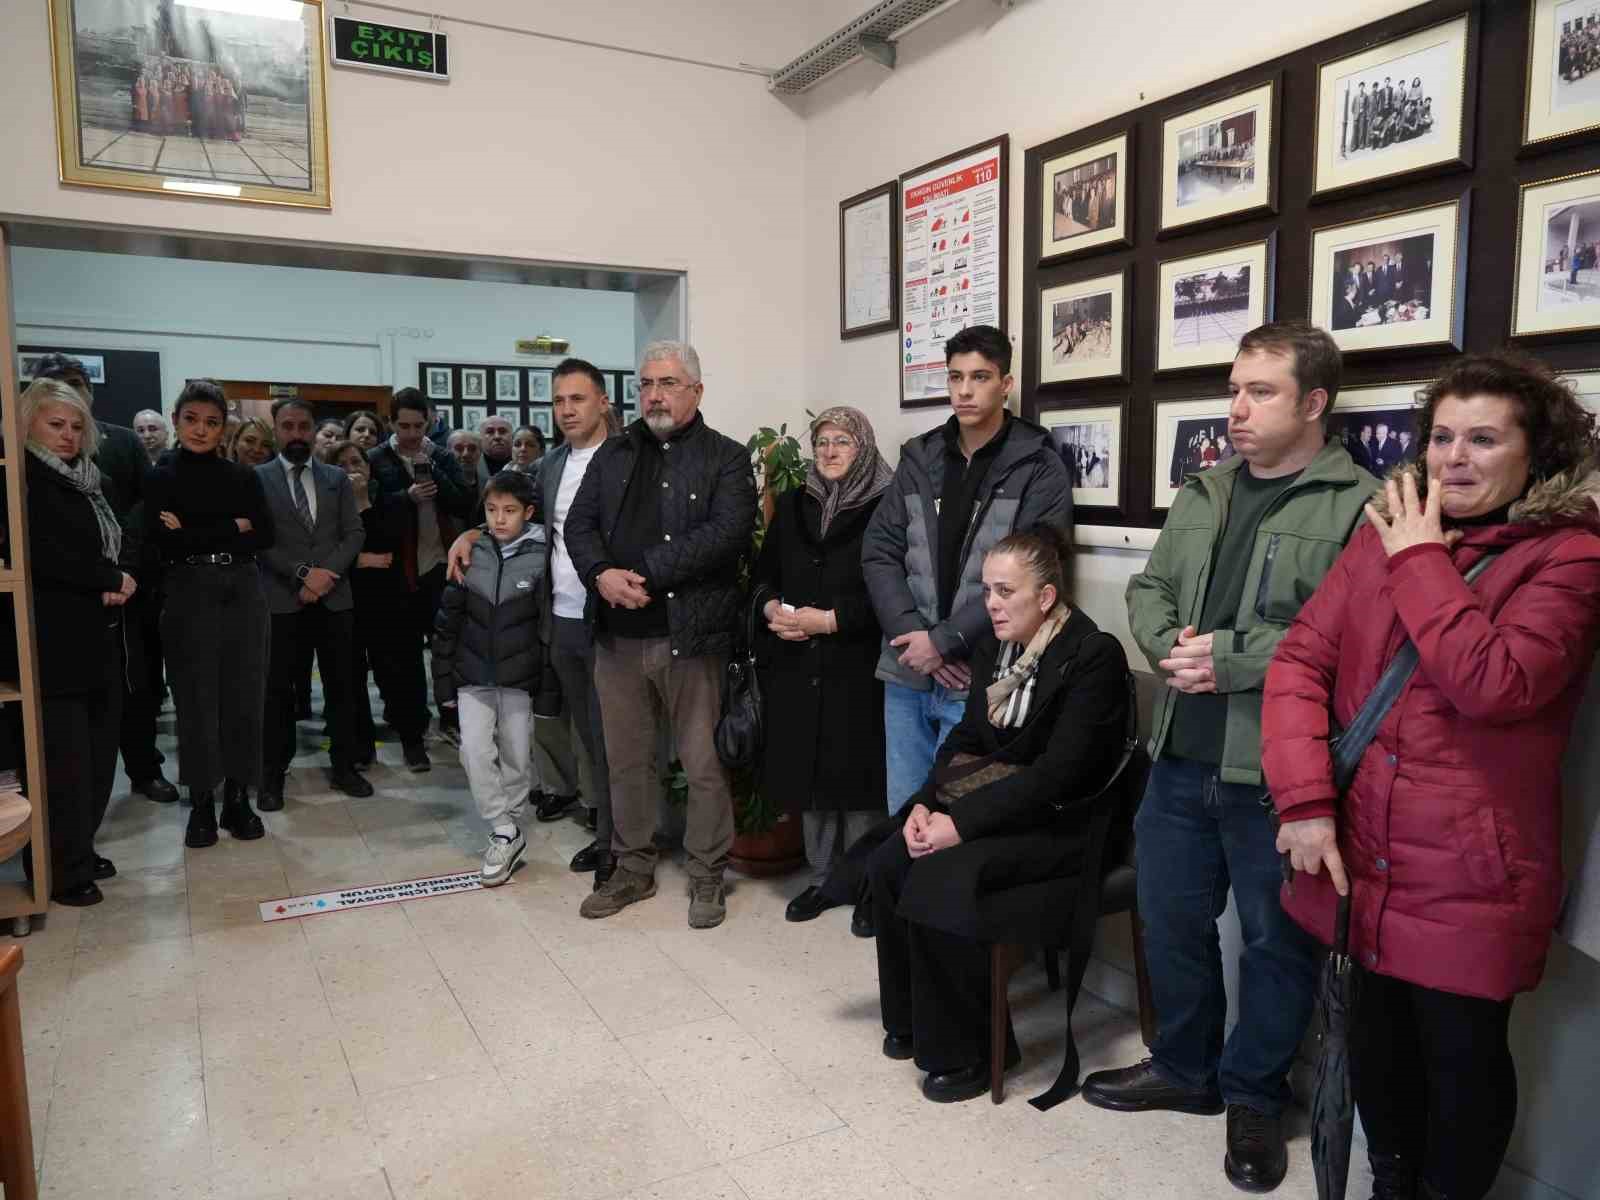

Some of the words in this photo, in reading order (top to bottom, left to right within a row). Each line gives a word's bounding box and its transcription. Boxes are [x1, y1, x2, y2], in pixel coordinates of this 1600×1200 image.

[357, 25, 425, 47] EXIT
[351, 40, 433, 69] ÇIKIŞ
[975, 168, 992, 185] 110
[337, 893, 397, 906] SOSYAL
[340, 883, 413, 899] KORUYUN
